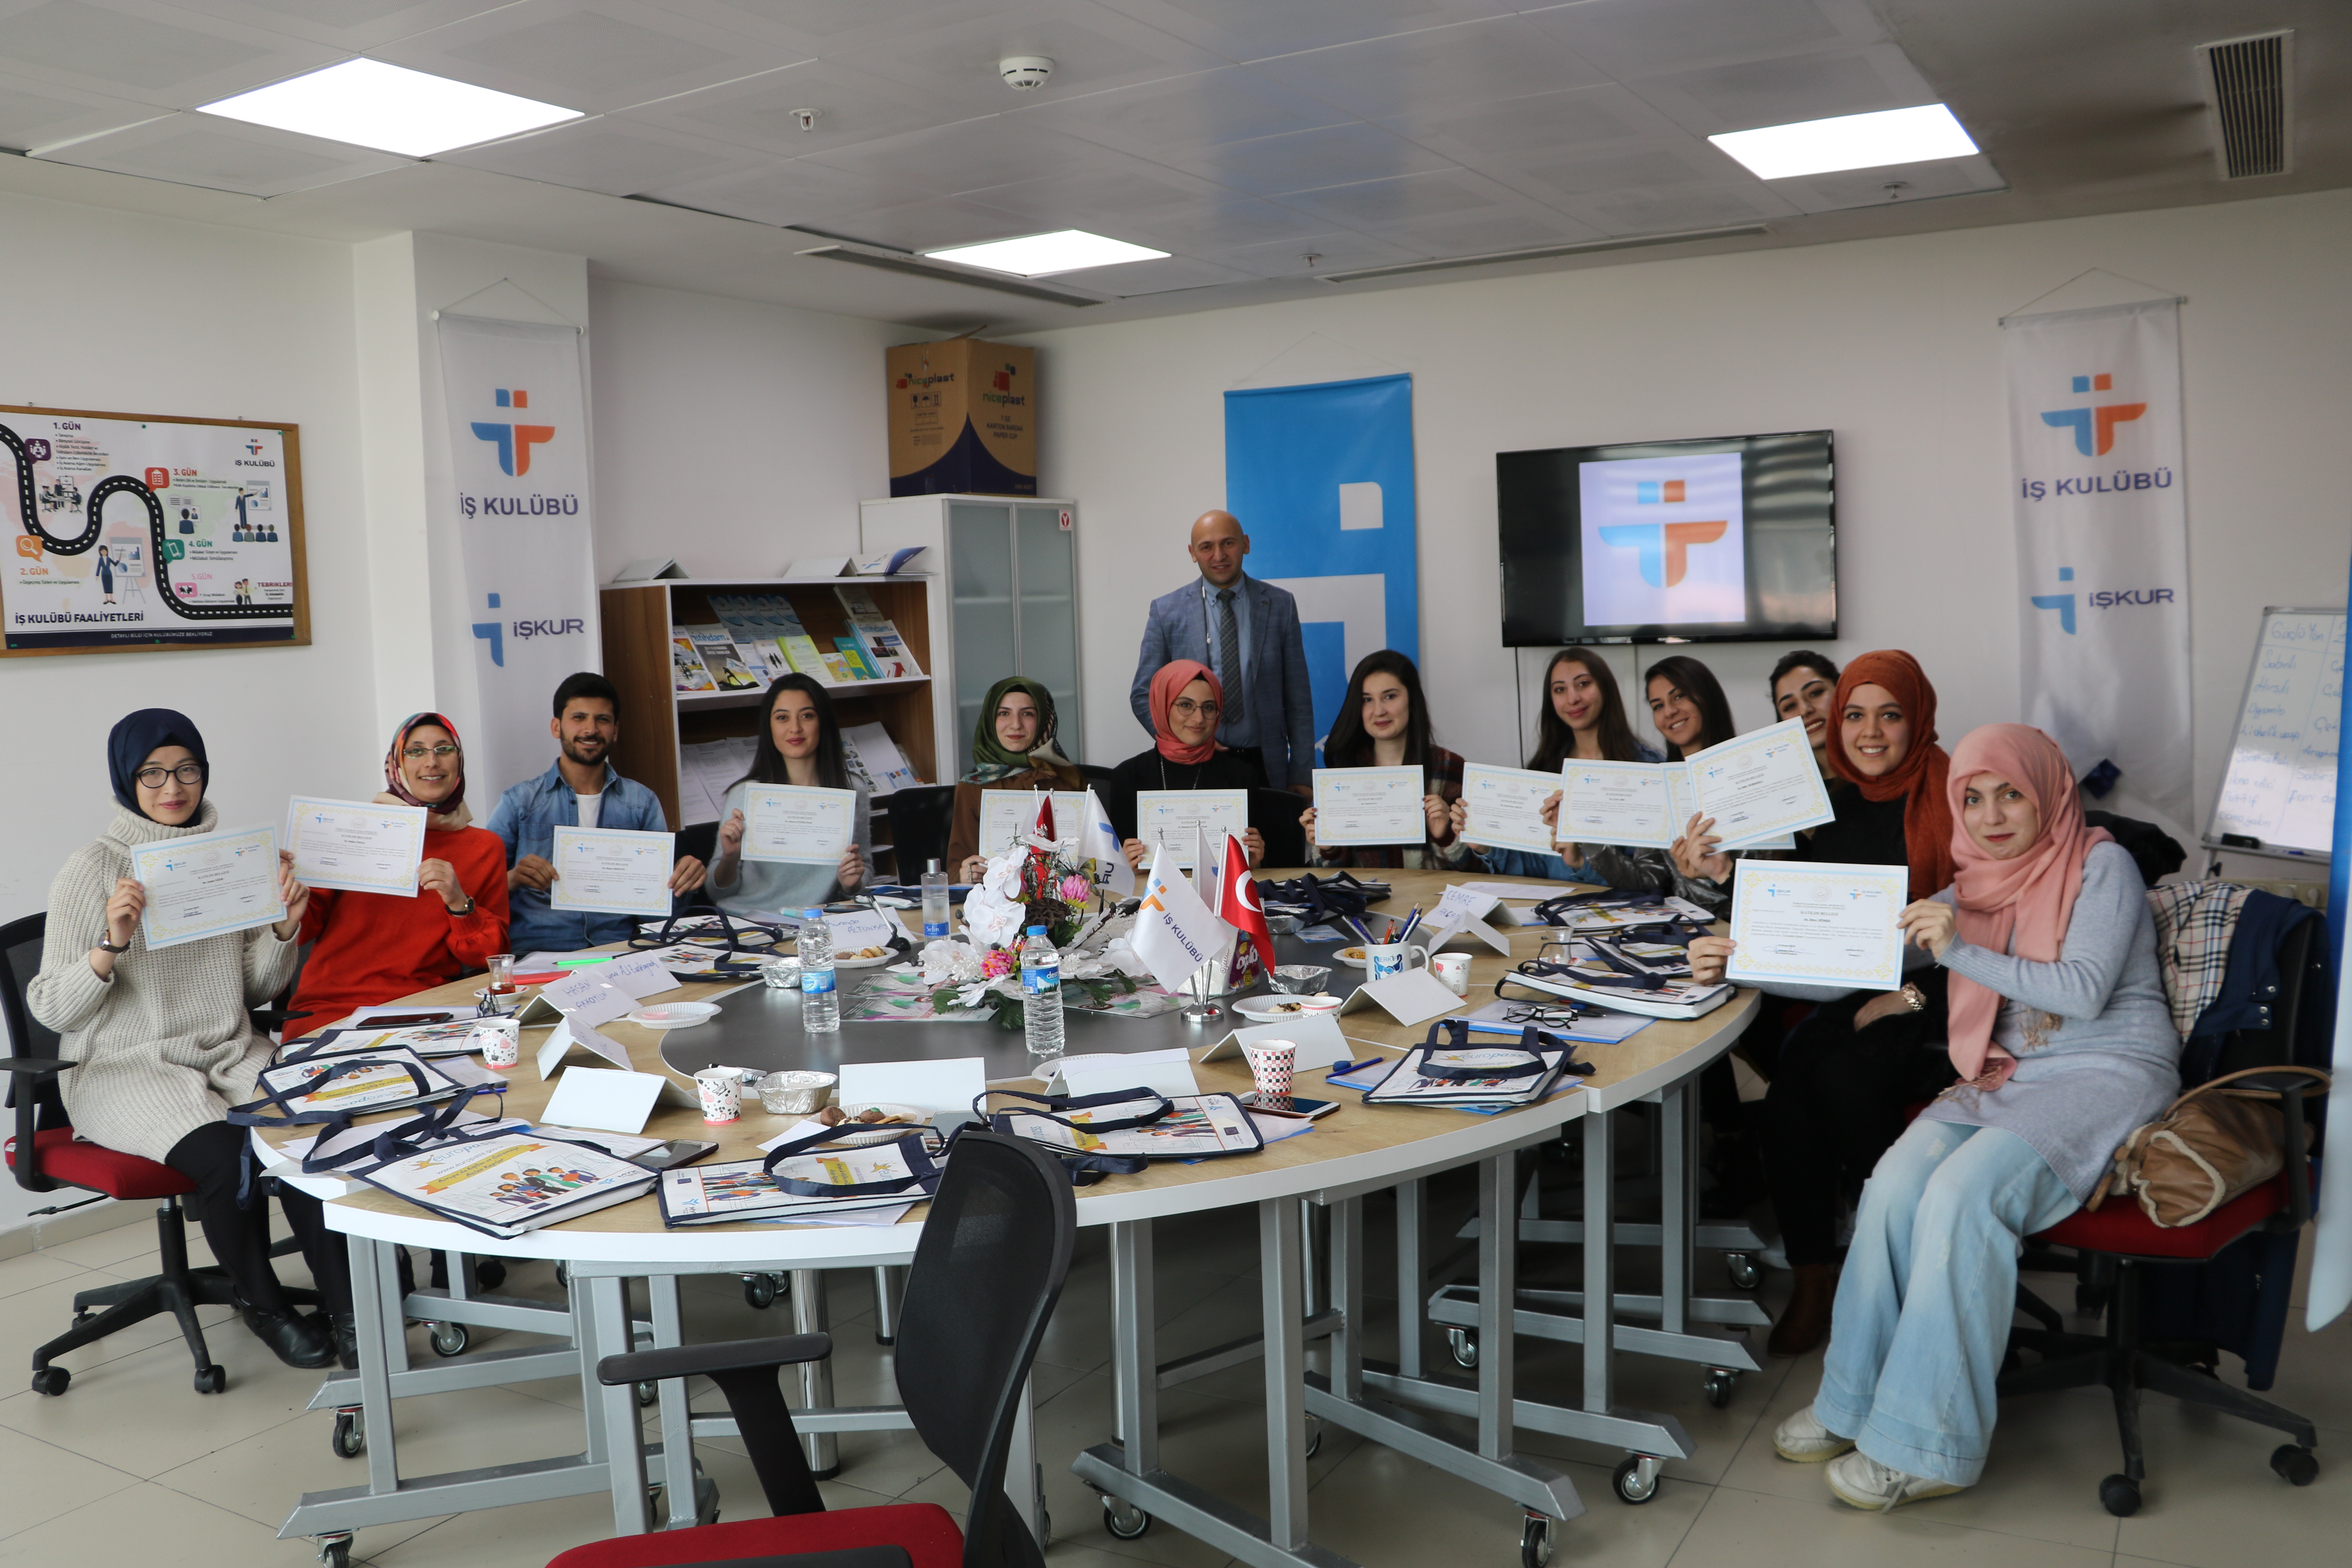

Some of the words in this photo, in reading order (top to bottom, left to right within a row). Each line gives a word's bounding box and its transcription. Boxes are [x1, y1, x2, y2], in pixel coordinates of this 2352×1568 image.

[983, 391, 1025, 407] niceplast
[62, 421, 81, 430] GÜN
[181, 467, 197, 476] GÜN
[2022, 477, 2046, 502] İŞ
[2056, 466, 2172, 495] KULÜBÜ
[460, 492, 476, 519] İŞ
[484, 494, 579, 515] KULÜBÜ
[196, 539, 212, 547] GÜN
[29, 566, 49, 575] GÜN
[2089, 588, 2174, 610] İŞKUR
[15, 612, 25, 626] İŞ
[28, 612, 71, 624] KULÜBÜ
[74, 610, 144, 622] FAALİYETLERİ
[513, 618, 584, 640] İŞKUR
[1446, 890, 1477, 906] CEMRE
[1163, 912, 1173, 925] İŞ
[1171, 924, 1203, 962] KULÜBÜ
[562, 978, 592, 997] HASAN
[575, 990, 608, 1010] AKKOYUN
[334, 1092, 397, 1107] europass
[432, 1141, 496, 1162] europass
[436, 1145, 504, 1175] www.europass.gov.tr
[617, 1170, 640, 1178] MYK
